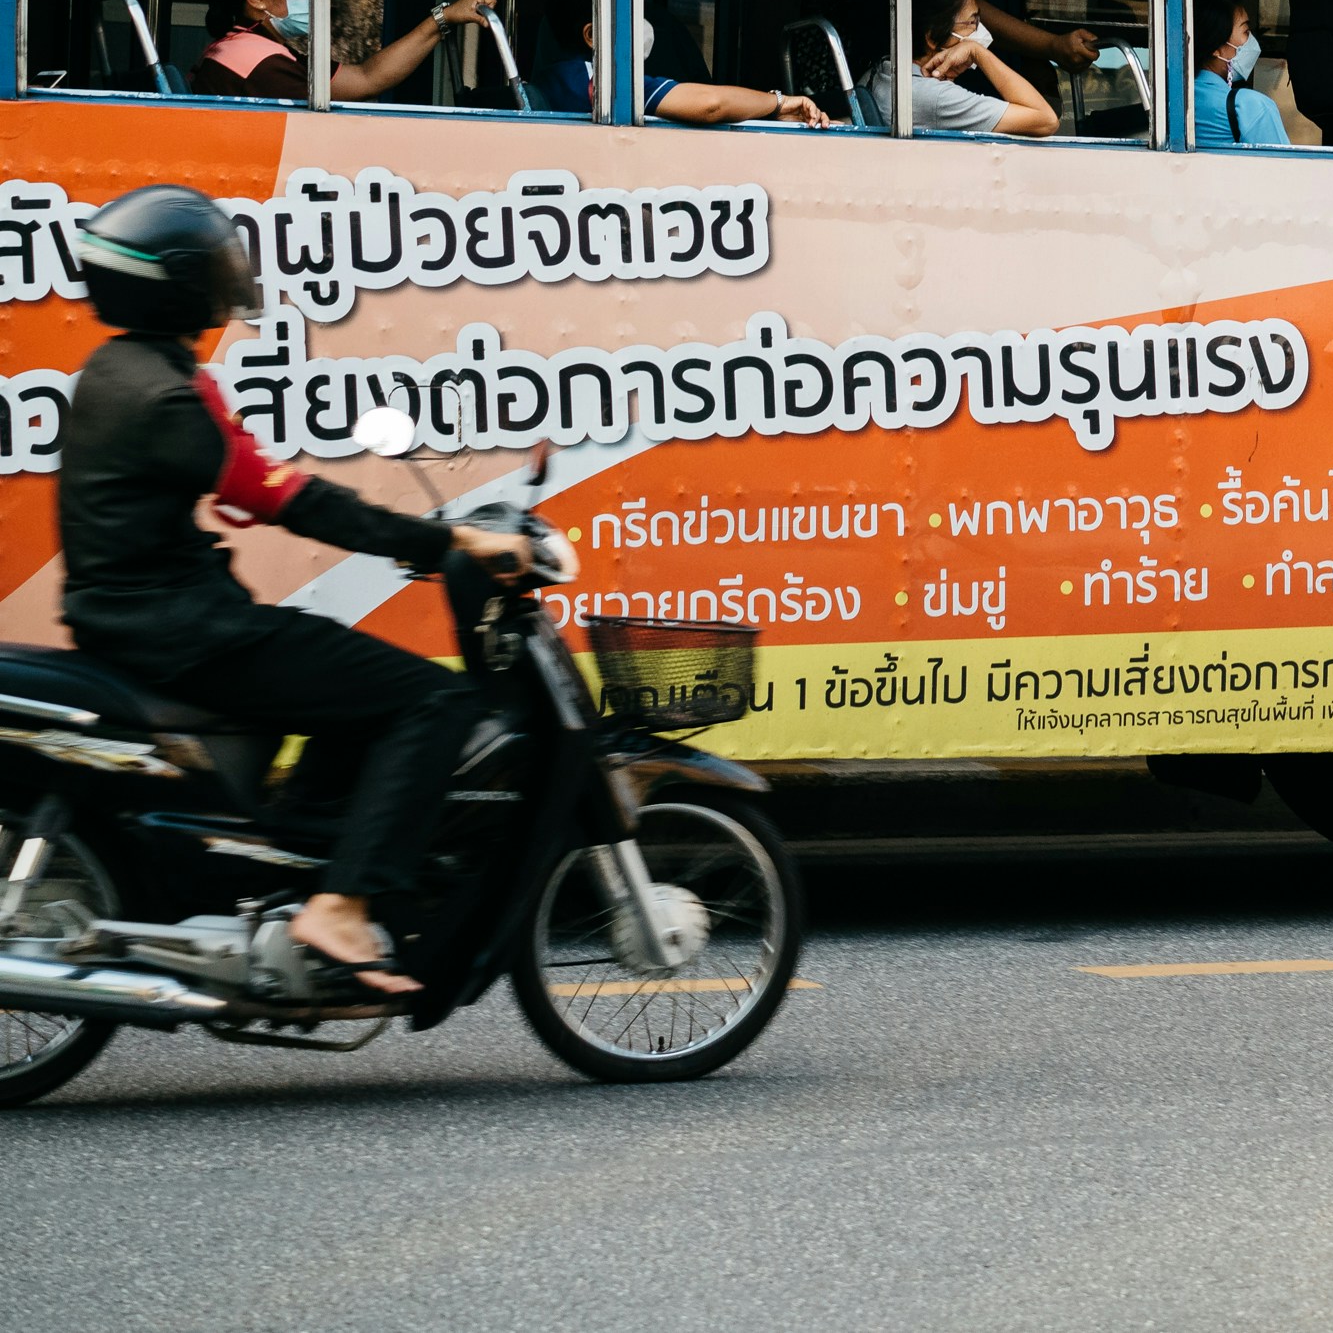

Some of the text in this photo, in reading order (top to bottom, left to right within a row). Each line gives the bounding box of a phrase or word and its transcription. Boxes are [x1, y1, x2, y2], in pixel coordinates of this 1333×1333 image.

[592, 495, 906, 550] กรีดข่วนแขนขา
[948, 492, 1179, 545] พกพาอาวุธ
[923, 566, 1007, 631] ข่มขู่
[1084, 555, 1209, 606] ทำร้าย
[795, 676, 807, 711] 1
[825, 652, 968, 709] ข้อขึ้นไป
[1015, 695, 1314, 735] ให้แจ้งบุคลากรสาธารณสุขในพื้นที่
